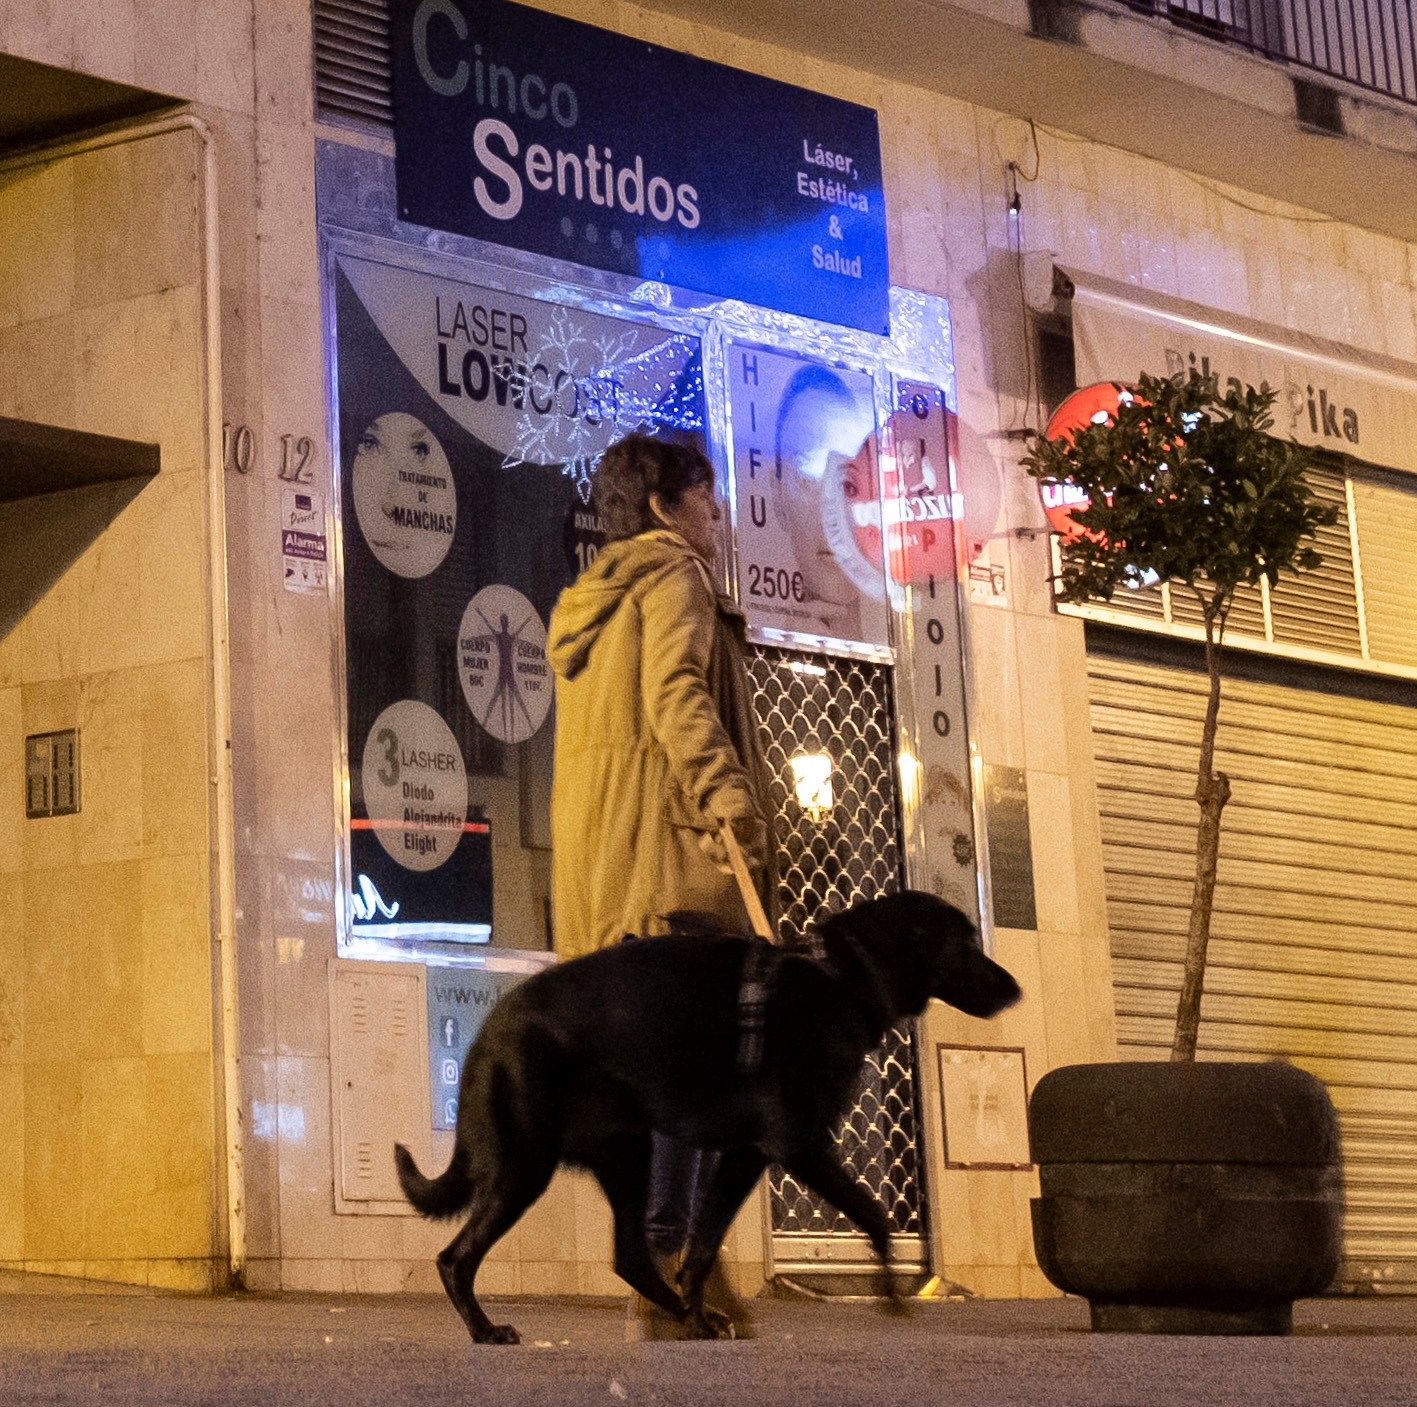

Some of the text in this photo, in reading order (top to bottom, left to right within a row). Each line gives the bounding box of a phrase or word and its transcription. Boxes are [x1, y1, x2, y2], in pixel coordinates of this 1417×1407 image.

[473, 118, 701, 230] Sentidos
[802, 139, 859, 181] Láser,
[796, 171, 870, 214] Estética
[828, 214, 844, 241] &
[811, 243, 863, 280] Salud
[435, 295, 528, 354] LASER
[278, 433, 315, 484] 12
[393, 506, 453, 534] MANCHAS
[285, 533, 324, 552] Alarma
[747, 564, 805, 604] 250€
[462, 655, 489, 671] MUJER
[377, 728, 457, 788] 3 LASHER
[402, 780, 435, 802] Diodo
[404, 832, 437, 857] Elight
